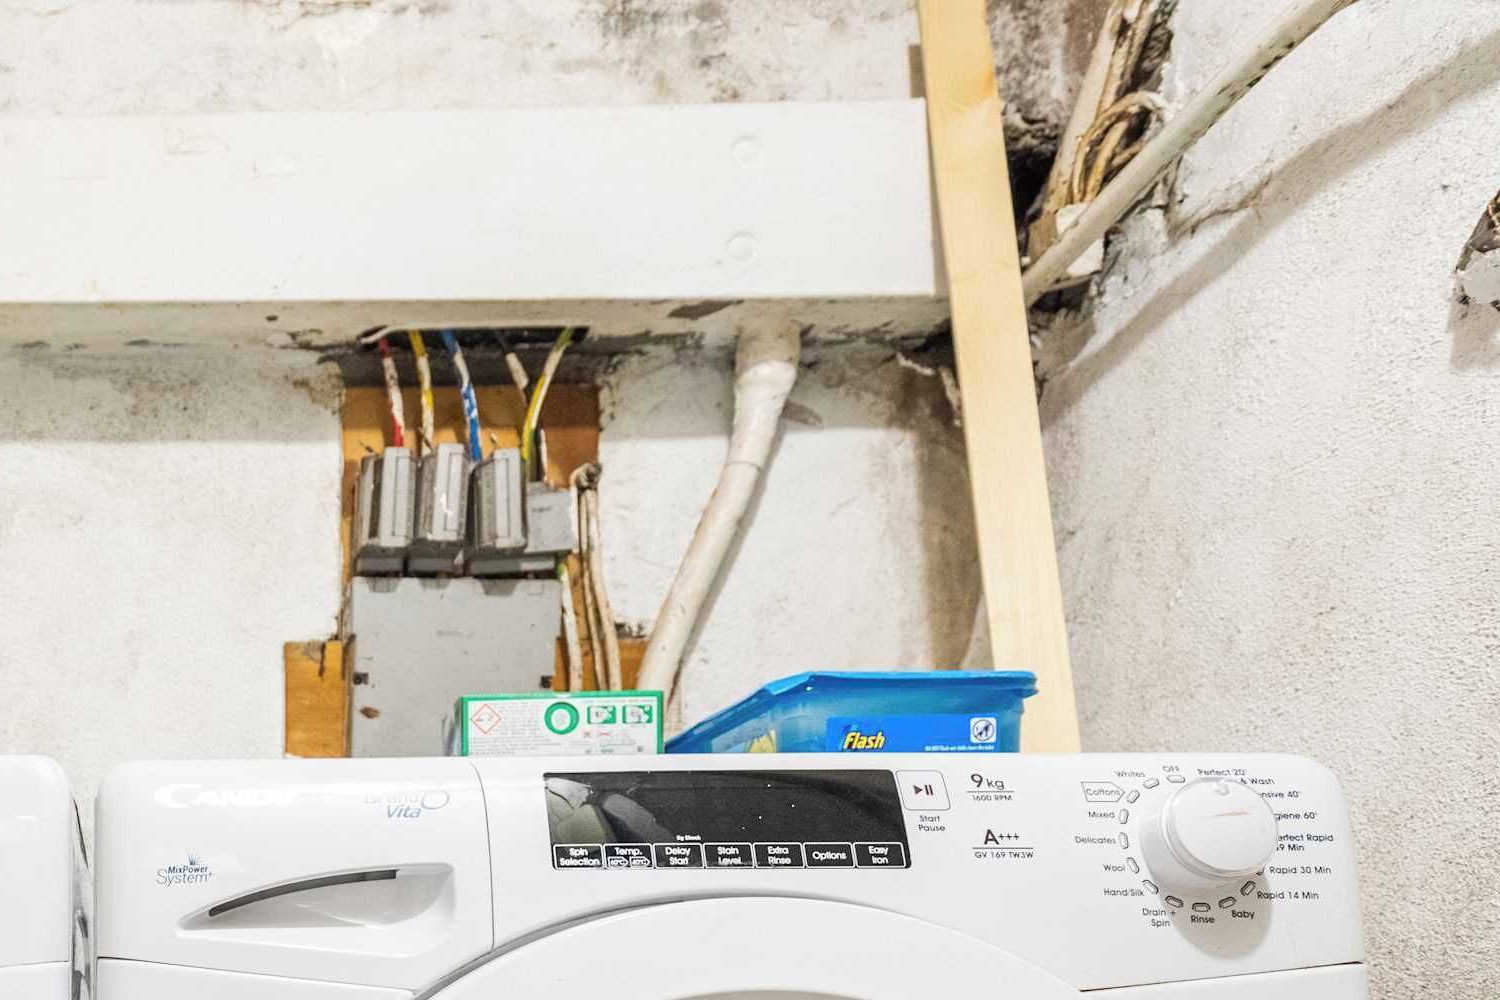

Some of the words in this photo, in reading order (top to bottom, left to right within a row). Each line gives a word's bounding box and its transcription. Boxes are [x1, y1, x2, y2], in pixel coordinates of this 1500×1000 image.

[843, 730, 885, 750] Flash
[1114, 770, 1146, 778] Whites
[1198, 768, 1229, 777] Perfect
[1250, 777, 1275, 785] Wash
[1086, 788, 1121, 796] Cottons
[1260, 790, 1285, 799] nsive
[388, 805, 421, 819] Vita
[1088, 810, 1115, 819] Mixed
[919, 813, 941, 823] Start
[918, 823, 946, 834] Pause
[984, 829, 1020, 845] A+++
[1075, 835, 1116, 844] Delicates
[1278, 833, 1305, 842] erfect
[1307, 833, 1333, 843] Rapid
[665, 846, 690, 857] Delay
[717, 846, 739, 856] Stain
[768, 846, 789, 856] Extra
[868, 845, 889, 857] Easy
[1287, 843, 1304, 851] Min
[569, 848, 589, 858] Spin
[614, 847, 643, 858] Temp.
[813, 850, 847, 861] Options
[974, 851, 987, 859] GV
[991, 851, 1005, 859] 169
[560, 857, 601, 866] Selection
[669, 857, 690, 866] Start
[718, 856, 741, 866] Level
[768, 856, 791, 866] Rinse
[872, 855, 888, 864] Iron
[168, 865, 208, 874] MixPower
[1103, 863, 1126, 872] Wool
[1269, 866, 1298, 876] Rapid
[1300, 866, 1312, 875] 30
[1314, 866, 1332, 875] Min
[1257, 891, 1285, 902] Rapid
[1288, 891, 1299, 900] 14
[1302, 891, 1319, 900] Min
[1142, 908, 1167, 917] Drain
[1231, 909, 1256, 920] Baby
[1151, 918, 1171, 928] Spin
[1190, 914, 1215, 924] Rinse
